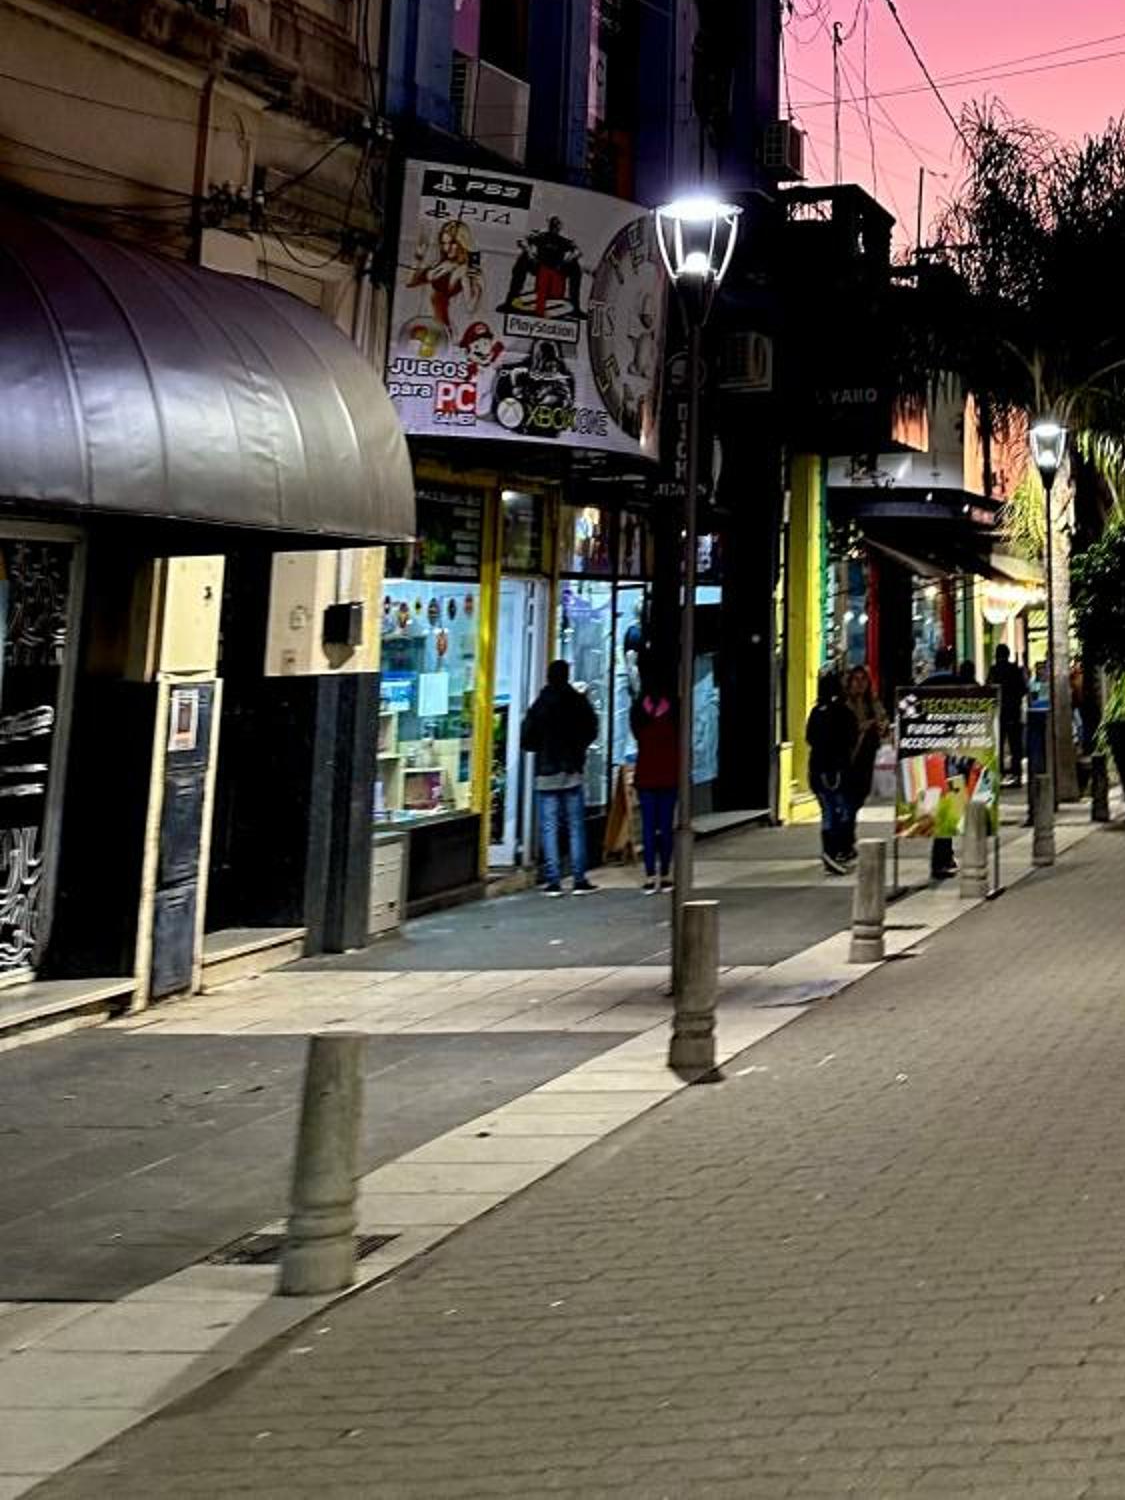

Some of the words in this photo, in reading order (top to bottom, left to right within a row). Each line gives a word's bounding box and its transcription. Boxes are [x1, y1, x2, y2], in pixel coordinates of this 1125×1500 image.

[458, 203, 511, 225] PS4
[509, 317, 577, 339] PlayStation
[390, 359, 469, 378] JUEGOS
[389, 382, 432, 398] para
[436, 382, 476, 412] PC
[526, 405, 577, 432] XBOX
